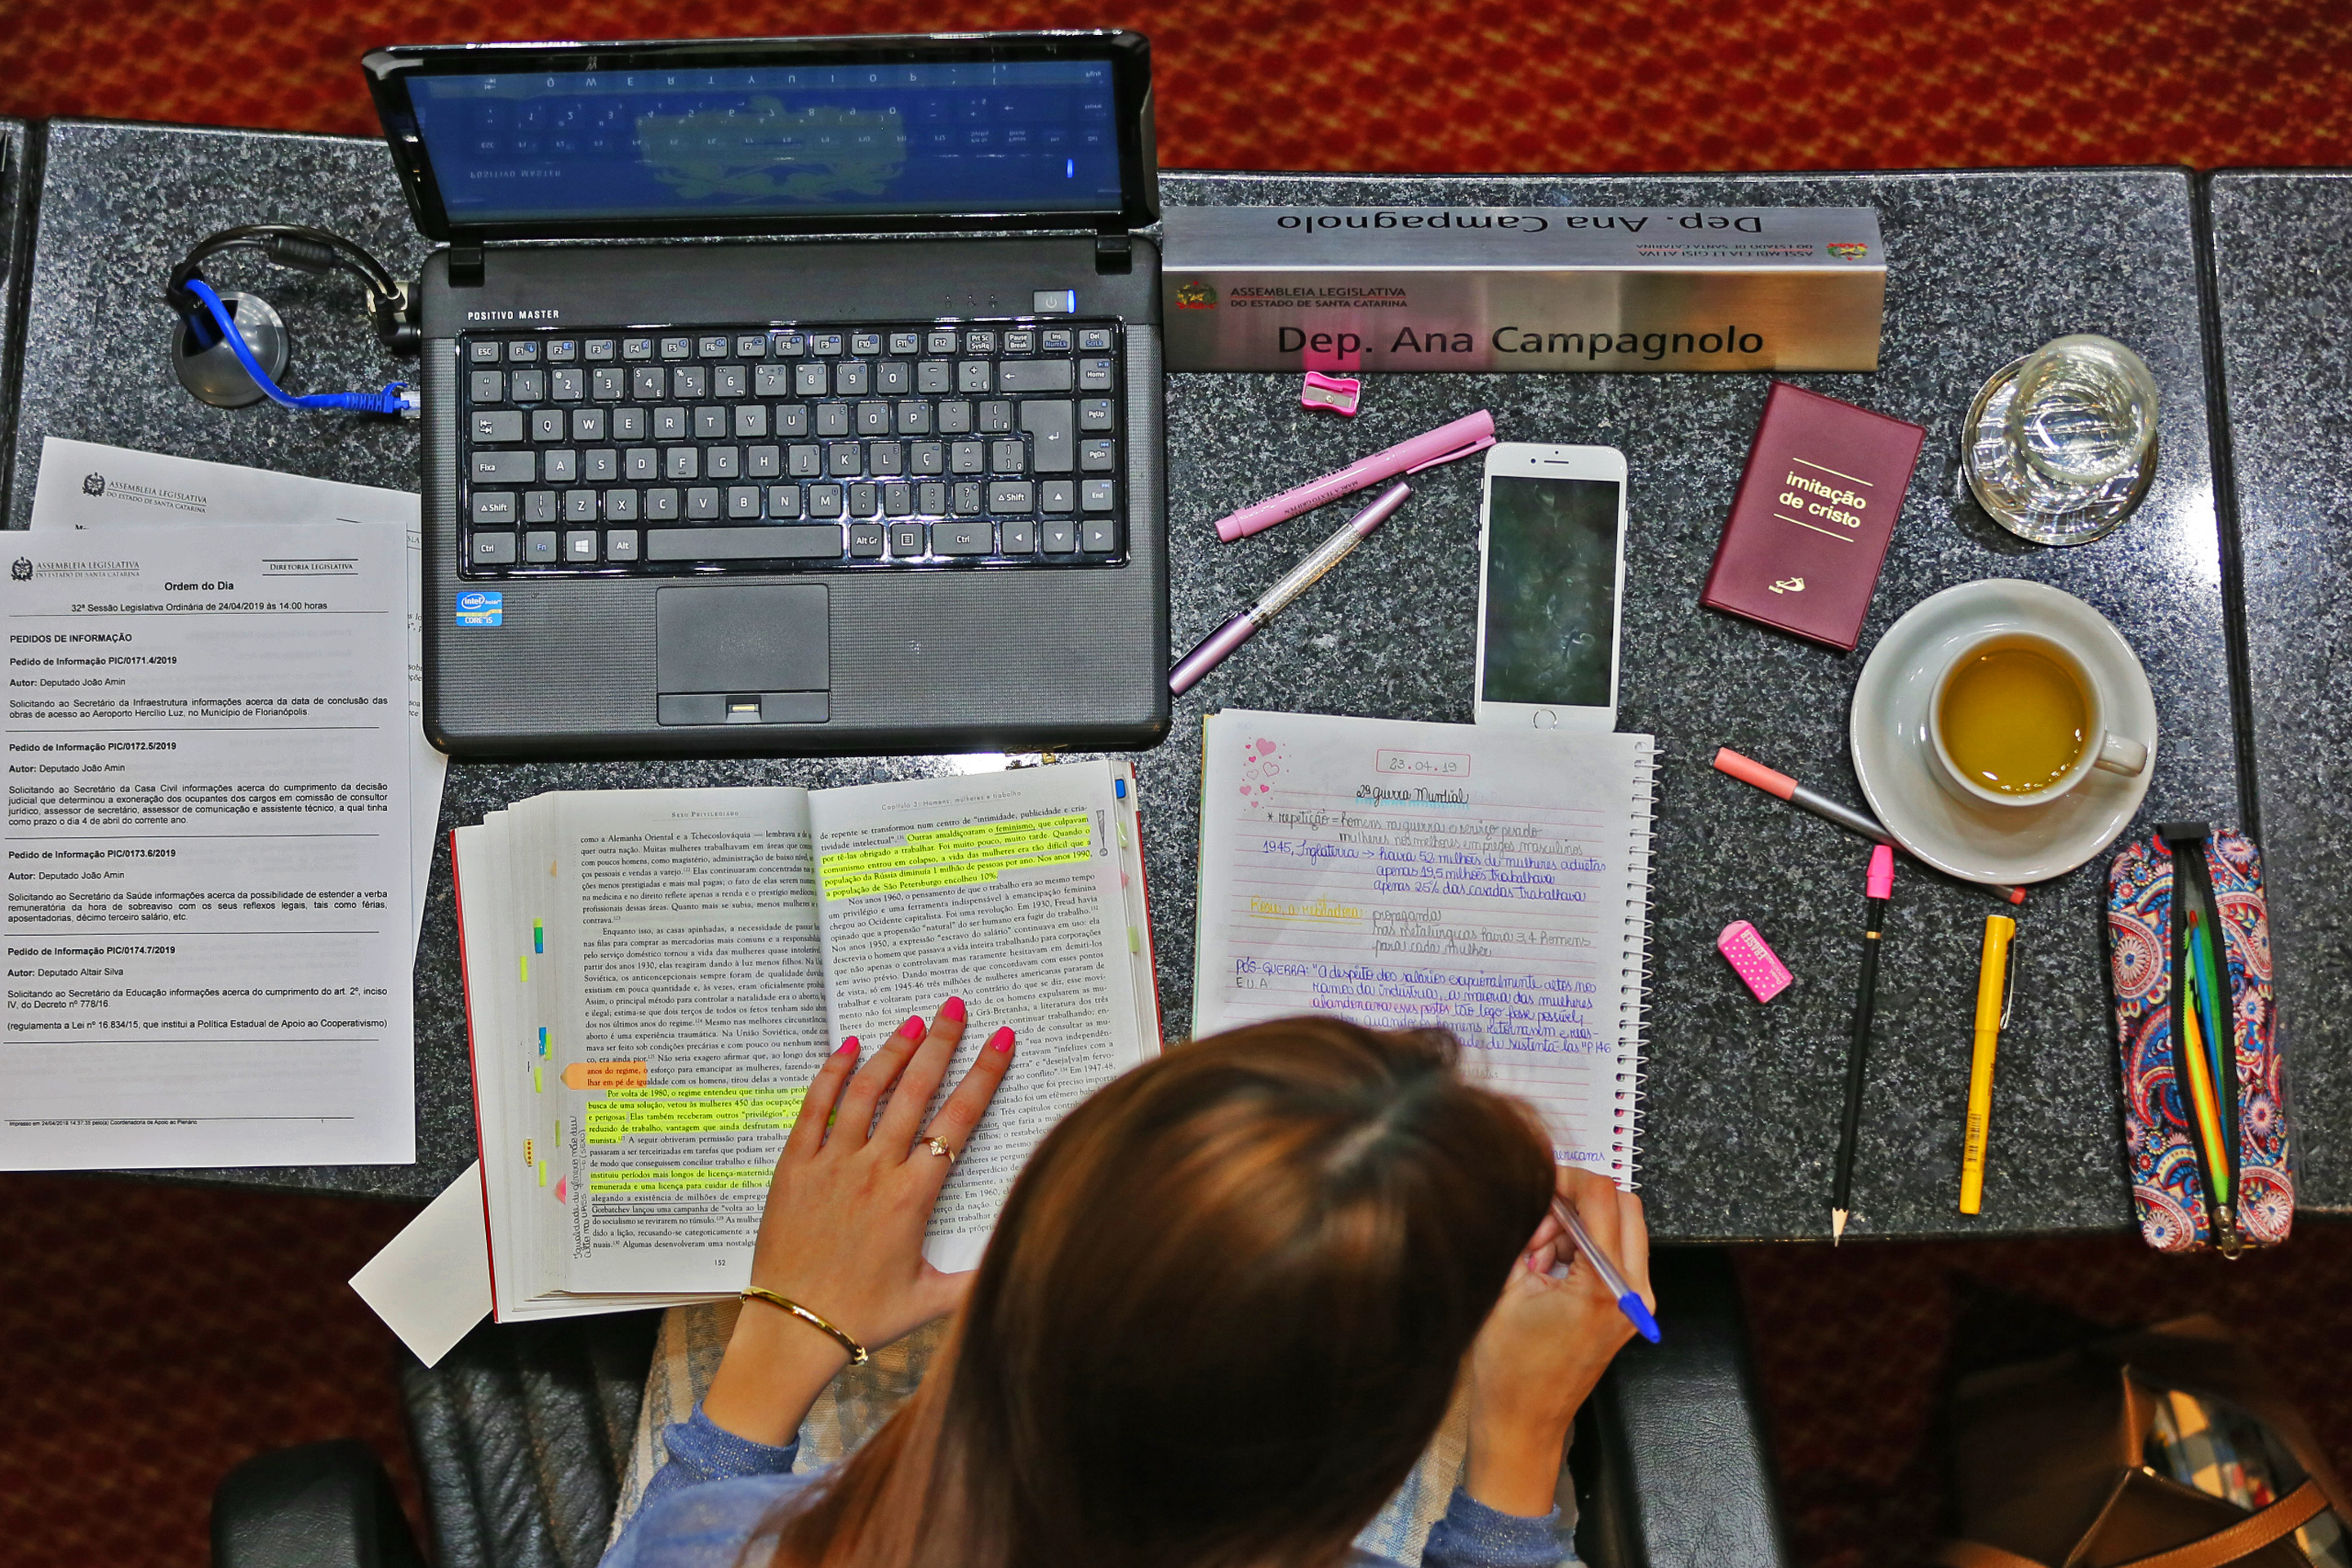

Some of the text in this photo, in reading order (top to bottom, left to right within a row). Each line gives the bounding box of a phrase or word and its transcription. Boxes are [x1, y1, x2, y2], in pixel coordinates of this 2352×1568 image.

[1276, 212, 1762, 234] Dep. Ana Campagnolo
[1231, 287, 1406, 296] ASSEMBLEIA LEGISLATIVA
[468, 310, 559, 320] POSITIVO MASTER
[1010, 335, 1027, 343] Pause
[1279, 325, 1762, 361] Dep. Ana Campagnolo
[707, 417, 714, 426] T
[748, 416, 754, 425] Y
[788, 416, 795, 425] U
[831, 416, 834, 424] I
[870, 415, 876, 423] O
[911, 414, 917, 422] P
[545, 421, 550, 431] Q
[583, 420, 594, 429] W
[626, 419, 631, 428] E
[666, 419, 673, 427] R
[679, 458, 685, 467] F
[720, 458, 726, 466] G
[761, 457, 768, 466] H
[804, 457, 806, 466] J
[842, 456, 848, 464] K
[884, 455, 889, 463] L
[924, 454, 929, 465] Ç
[557, 461, 564, 470] A
[599, 461, 604, 469] S
[639, 460, 645, 468] D
[1334, 481, 1358, 493] MARCA
[1786, 471, 1867, 509] imitação
[109, 481, 207, 504] ASSEMBLEIA LEGISLATIVA
[1312, 491, 1334, 503] TEXTO
[578, 501, 584, 510] Z
[619, 501, 625, 509] X
[660, 499, 666, 508] C
[700, 499, 706, 507] V
[741, 498, 747, 506] B
[782, 497, 788, 506] N
[822, 497, 830, 505] M
[1780, 492, 1861, 528] de cristo
[37, 560, 140, 570] ASSEMBLEIA LEGISLATIVA
[164, 581, 234, 591] Ordem do Dia
[87, 604, 118, 612] Sessão
[120, 604, 164, 613] Legislativa
[165, 603, 204, 612] Ordinária
[205, 603, 216, 611] de
[218, 602, 265, 611] 24/04/2019
[266, 602, 277, 610] às
[279, 601, 302, 610] 14:00
[304, 602, 328, 610] horas
[10, 632, 132, 644] PEDIDOS DE INFORMAÇÃO
[10, 656, 177, 667] Pedido de Informação PIC/0171.4/2019
[9, 678, 126, 688] Autor: Deputado João Amin
[9, 699, 56, 709] Solicitando
[73, 698, 116, 708] Secretário
[118, 698, 130, 707] da
[133, 698, 188, 706] Infraestrutura
[191, 697, 243, 708] informações
[276, 697, 287, 706] da
[291, 697, 310, 706] data
[313, 697, 324, 705] de
[327, 697, 369, 705] conclusão
[372, 696, 389, 705] das
[1414, 788, 1469, 804] Mundial
[881, 803, 911, 811] Capítulo
[608, 834, 643, 843] Alemanha
[644, 832, 674, 842] Oriental
[690, 831, 751, 840] Tchecoslováquia
[1263, 840, 1294, 856] 1945,
[1296, 840, 1359, 866] Inglaterra
[1419, 851, 1435, 863] 52
[1485, 853, 1501, 867] de
[1414, 881, 1440, 893] 25%
[1740, 929, 1769, 960] ERASER
[7, 946, 176, 956] Pedido de Informação PIC/0174.7/2019
[7, 967, 124, 978] Autor: Deputado Altair Silva
